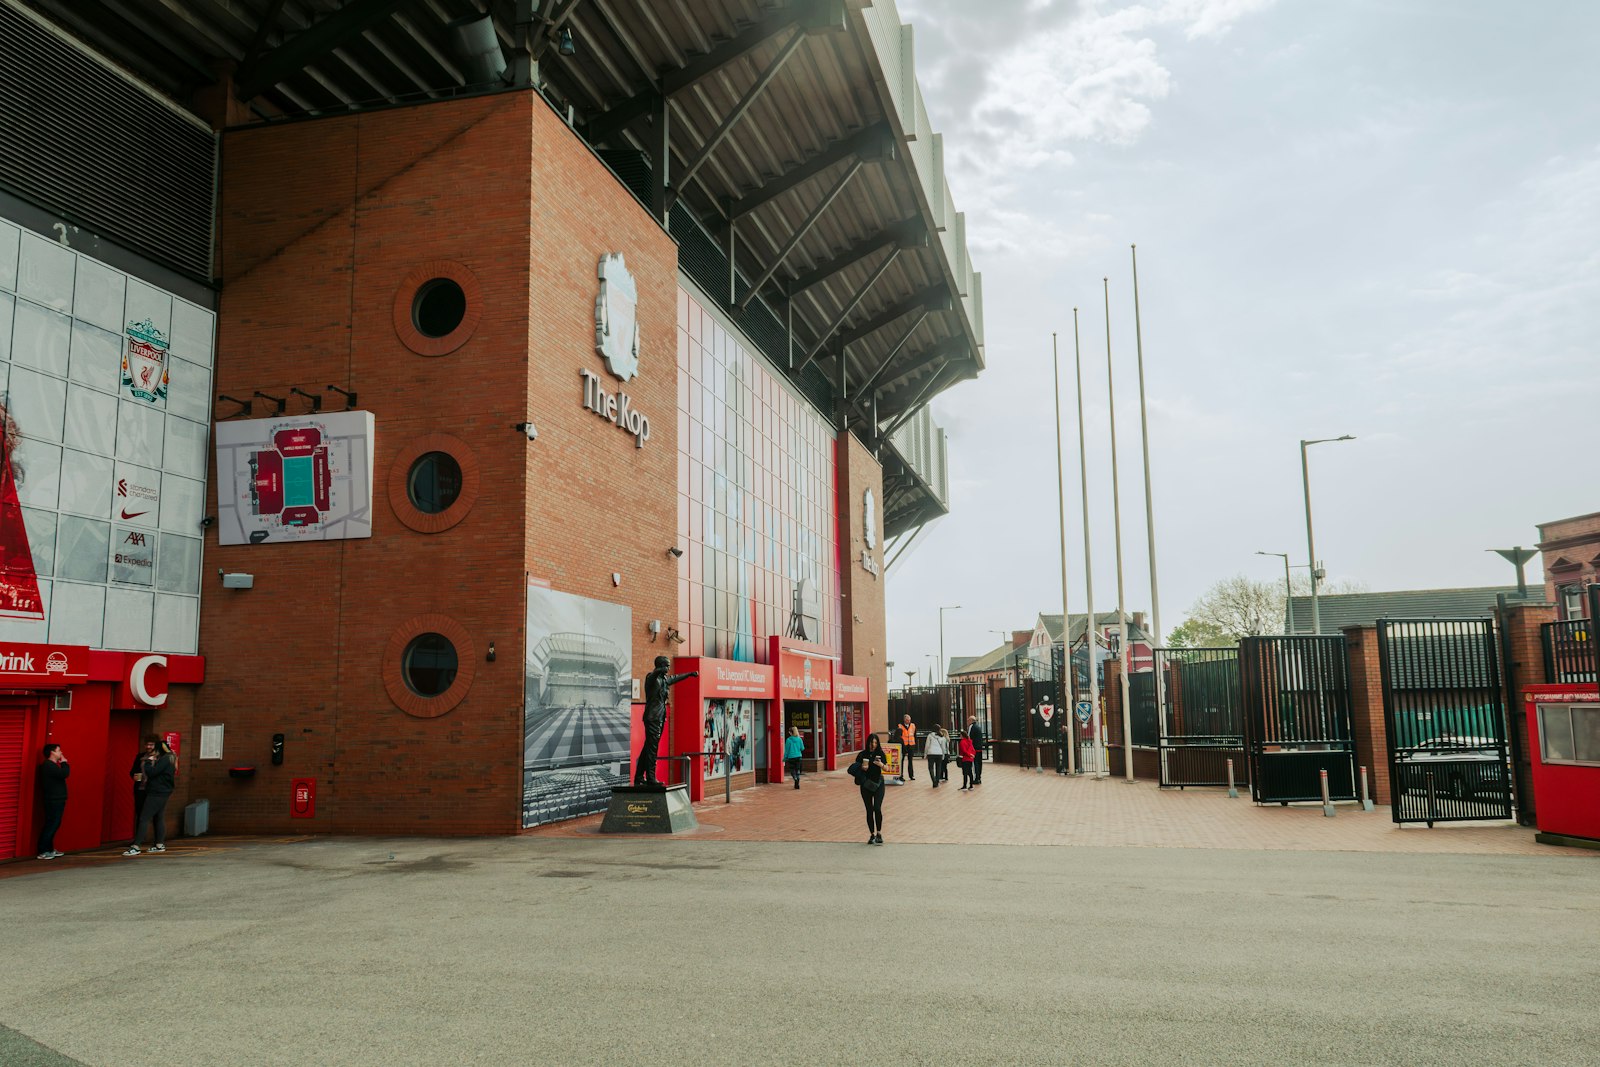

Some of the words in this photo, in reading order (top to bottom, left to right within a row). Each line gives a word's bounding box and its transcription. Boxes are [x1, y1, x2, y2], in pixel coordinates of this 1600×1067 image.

[130, 343, 162, 361] LIVERPOOL
[580, 368, 617, 423] The
[617, 391, 650, 448] Kop
[129, 490, 158, 502] chartered
[124, 531, 146, 547] AXA
[123, 556, 152, 568] Expedia
[0, 652, 34, 672] rink
[130, 655, 168, 706] C
[717, 666, 725, 680] The
[726, 668, 744, 684] Liverpool
